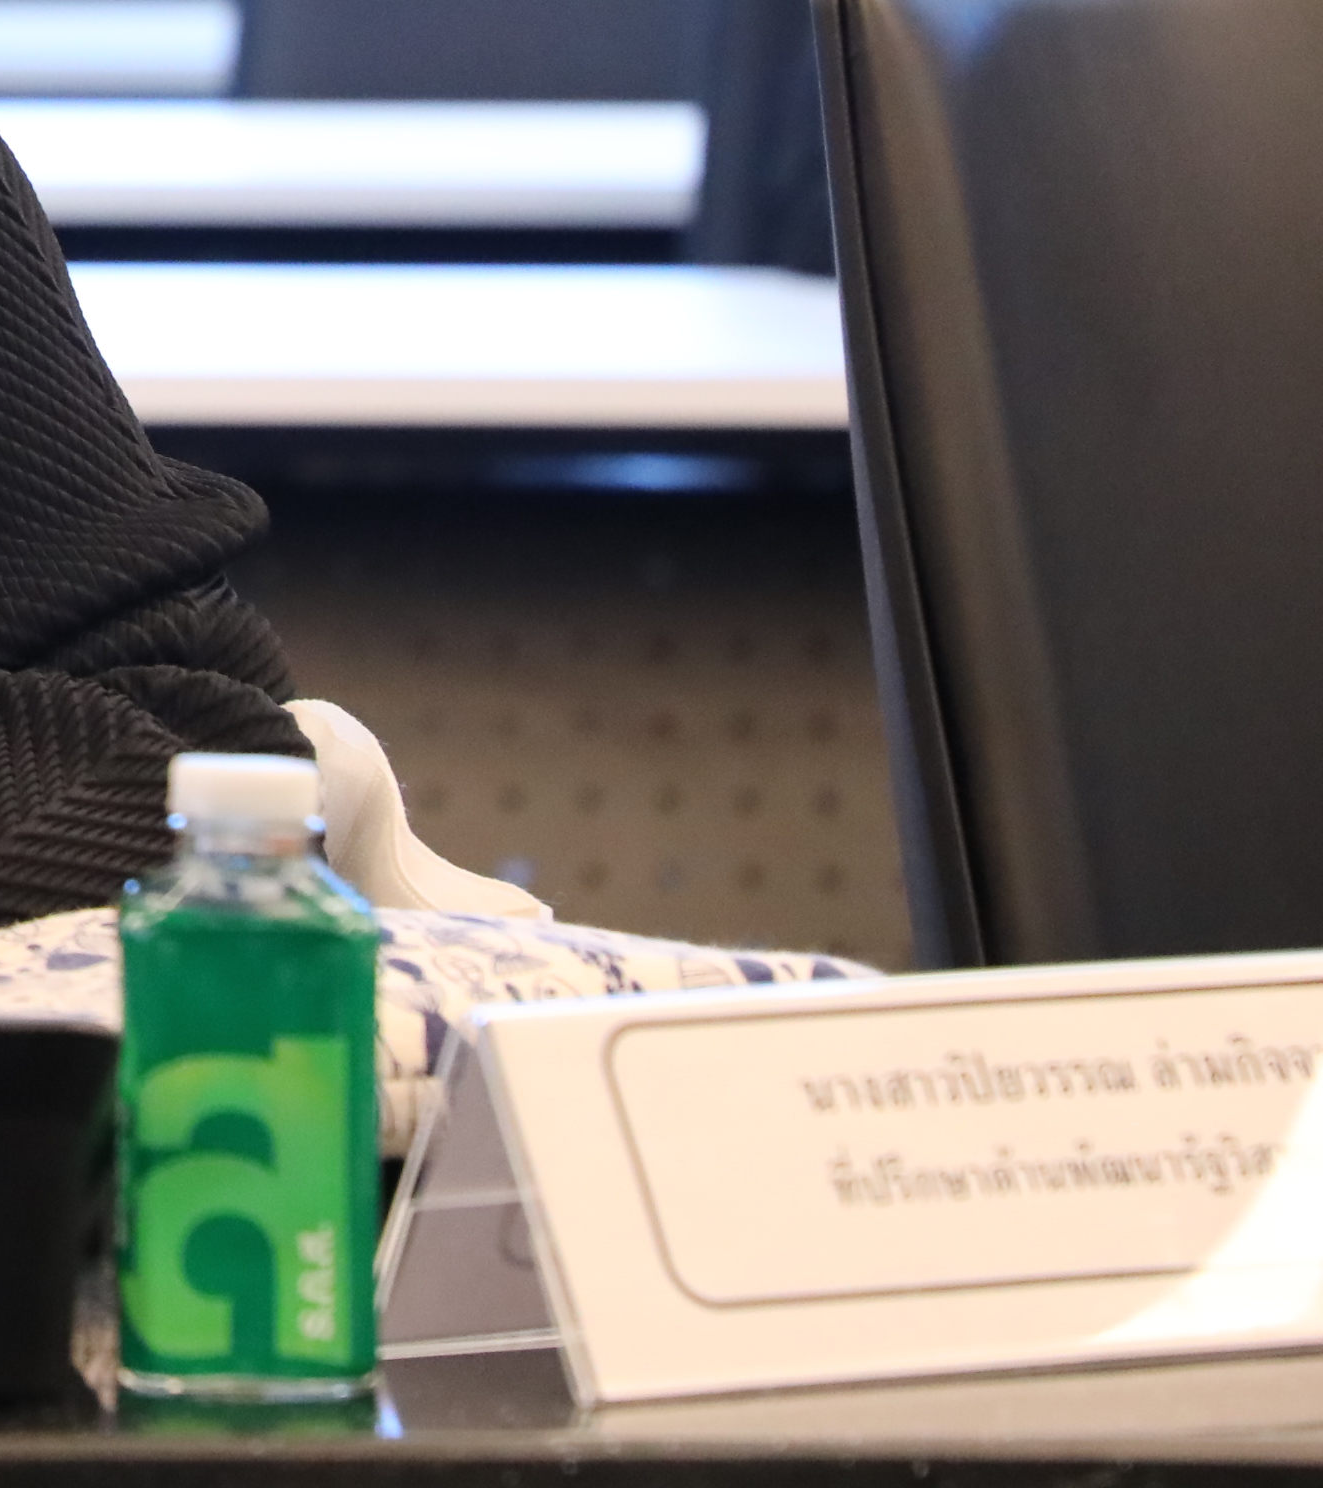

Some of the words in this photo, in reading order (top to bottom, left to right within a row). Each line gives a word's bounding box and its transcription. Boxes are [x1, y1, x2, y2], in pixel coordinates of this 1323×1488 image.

[800, 1048, 1136, 1113] นางสาวปิยวรรณ
[1150, 1030, 1323, 1091] ล่ามกิจจ
[827, 1128, 1284, 1207] ที่ปรึกษาด้านพัฒนารัฐวิส
